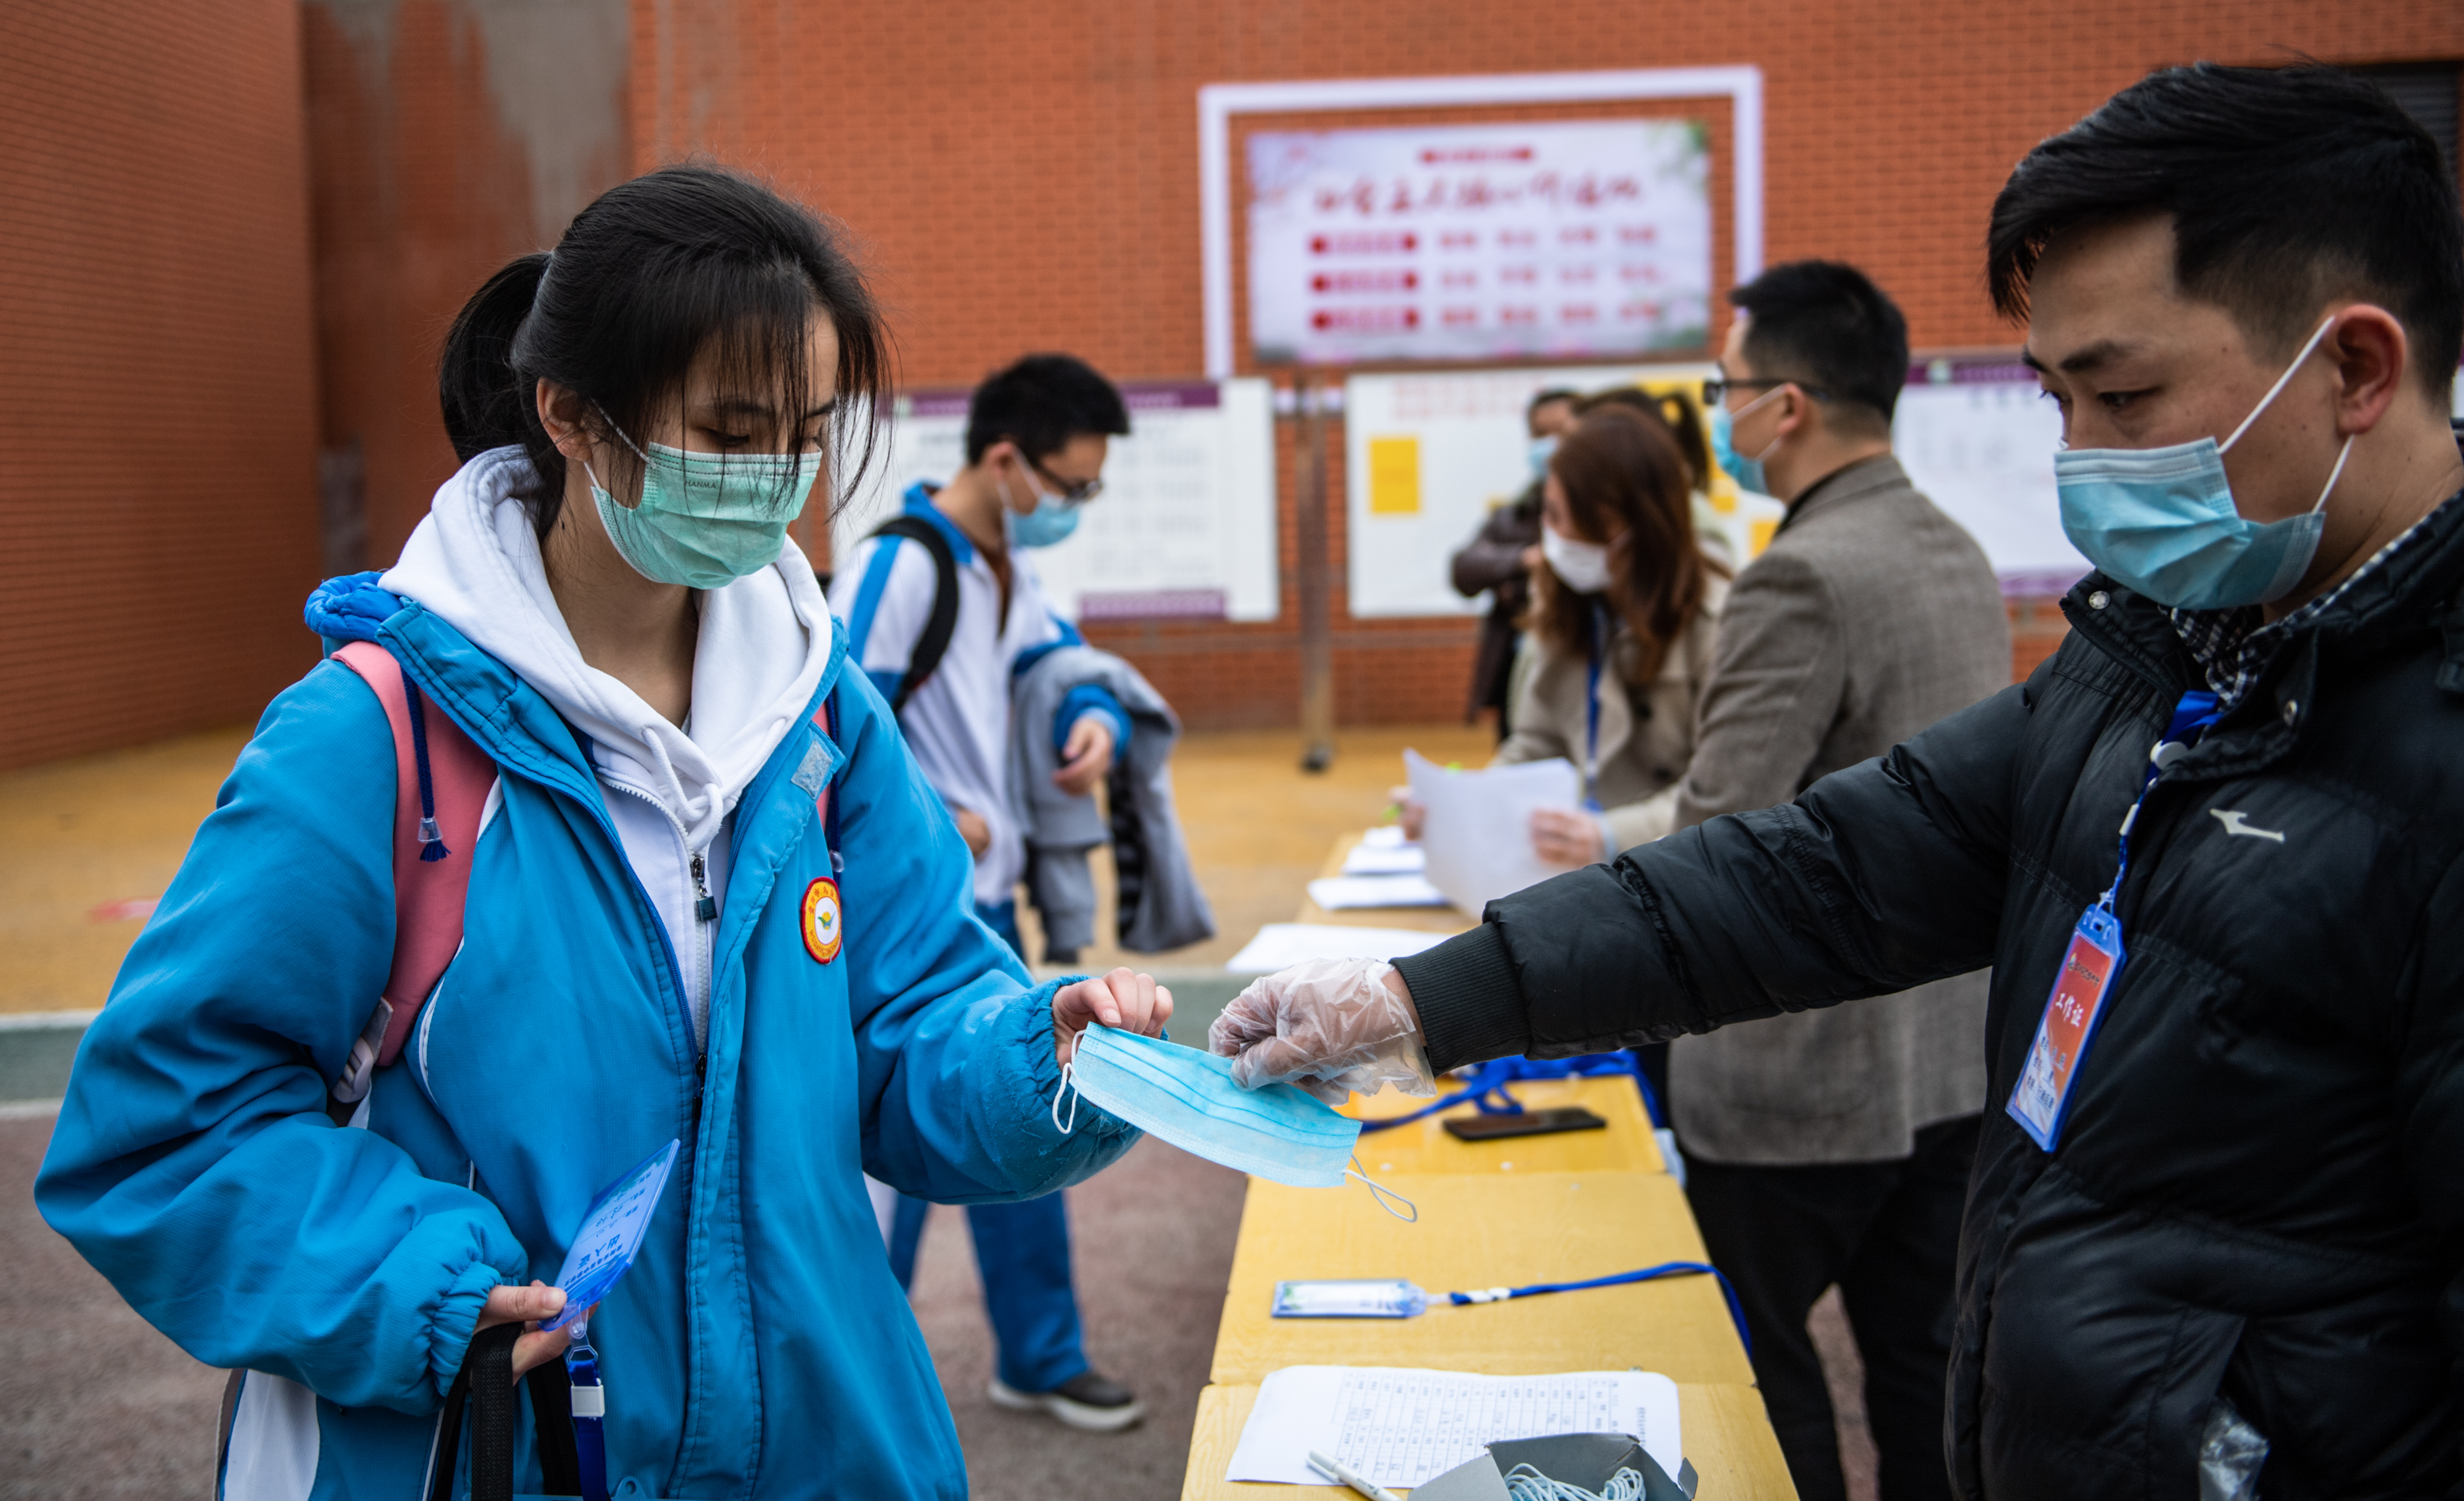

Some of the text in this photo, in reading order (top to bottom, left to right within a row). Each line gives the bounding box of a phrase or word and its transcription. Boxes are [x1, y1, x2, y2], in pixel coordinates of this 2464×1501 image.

[684, 480, 716, 489] HANMA
[2055, 992, 2084, 1027] 工作证
[577, 1233, 621, 1269] 出入证
